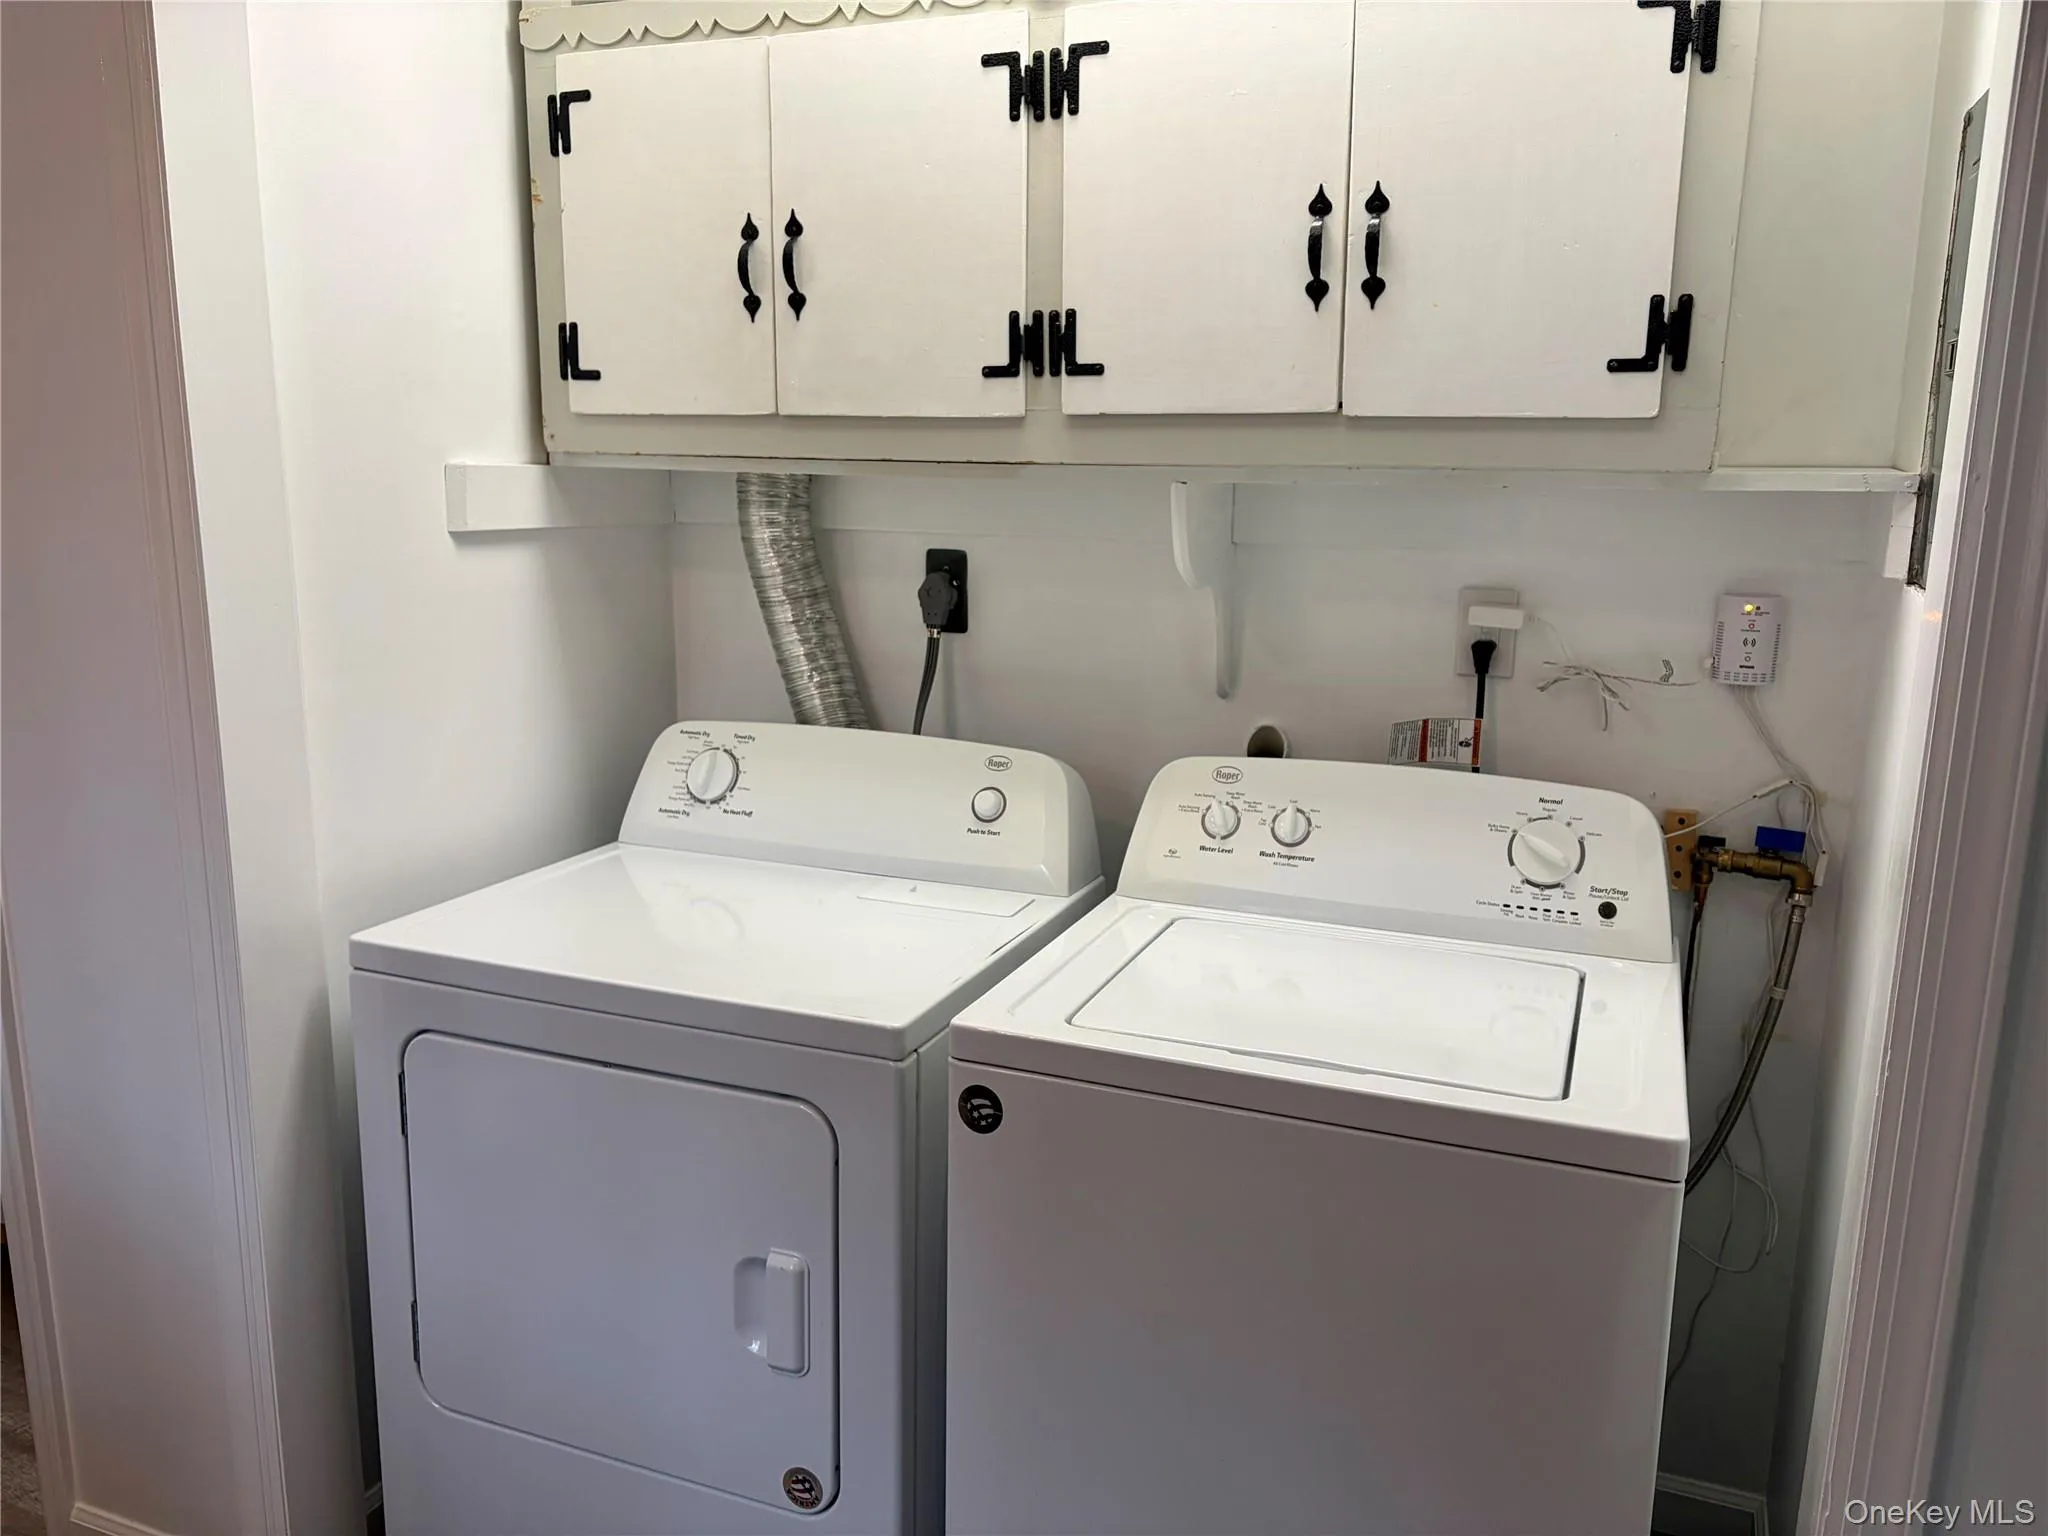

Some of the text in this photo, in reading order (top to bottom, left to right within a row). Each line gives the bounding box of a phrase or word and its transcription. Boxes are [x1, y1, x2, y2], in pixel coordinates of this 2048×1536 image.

[988, 758, 1010, 768] Roper
[1215, 769, 1240, 782] Roper
[1538, 796, 1564, 806] Normal
[682, 808, 690, 817] Dry
[742, 810, 754, 818] Fluff
[1199, 845, 1234, 854] Water Level
[1259, 850, 1316, 863] Wash Temperature
[1590, 885, 1629, 897] Start/Stop
